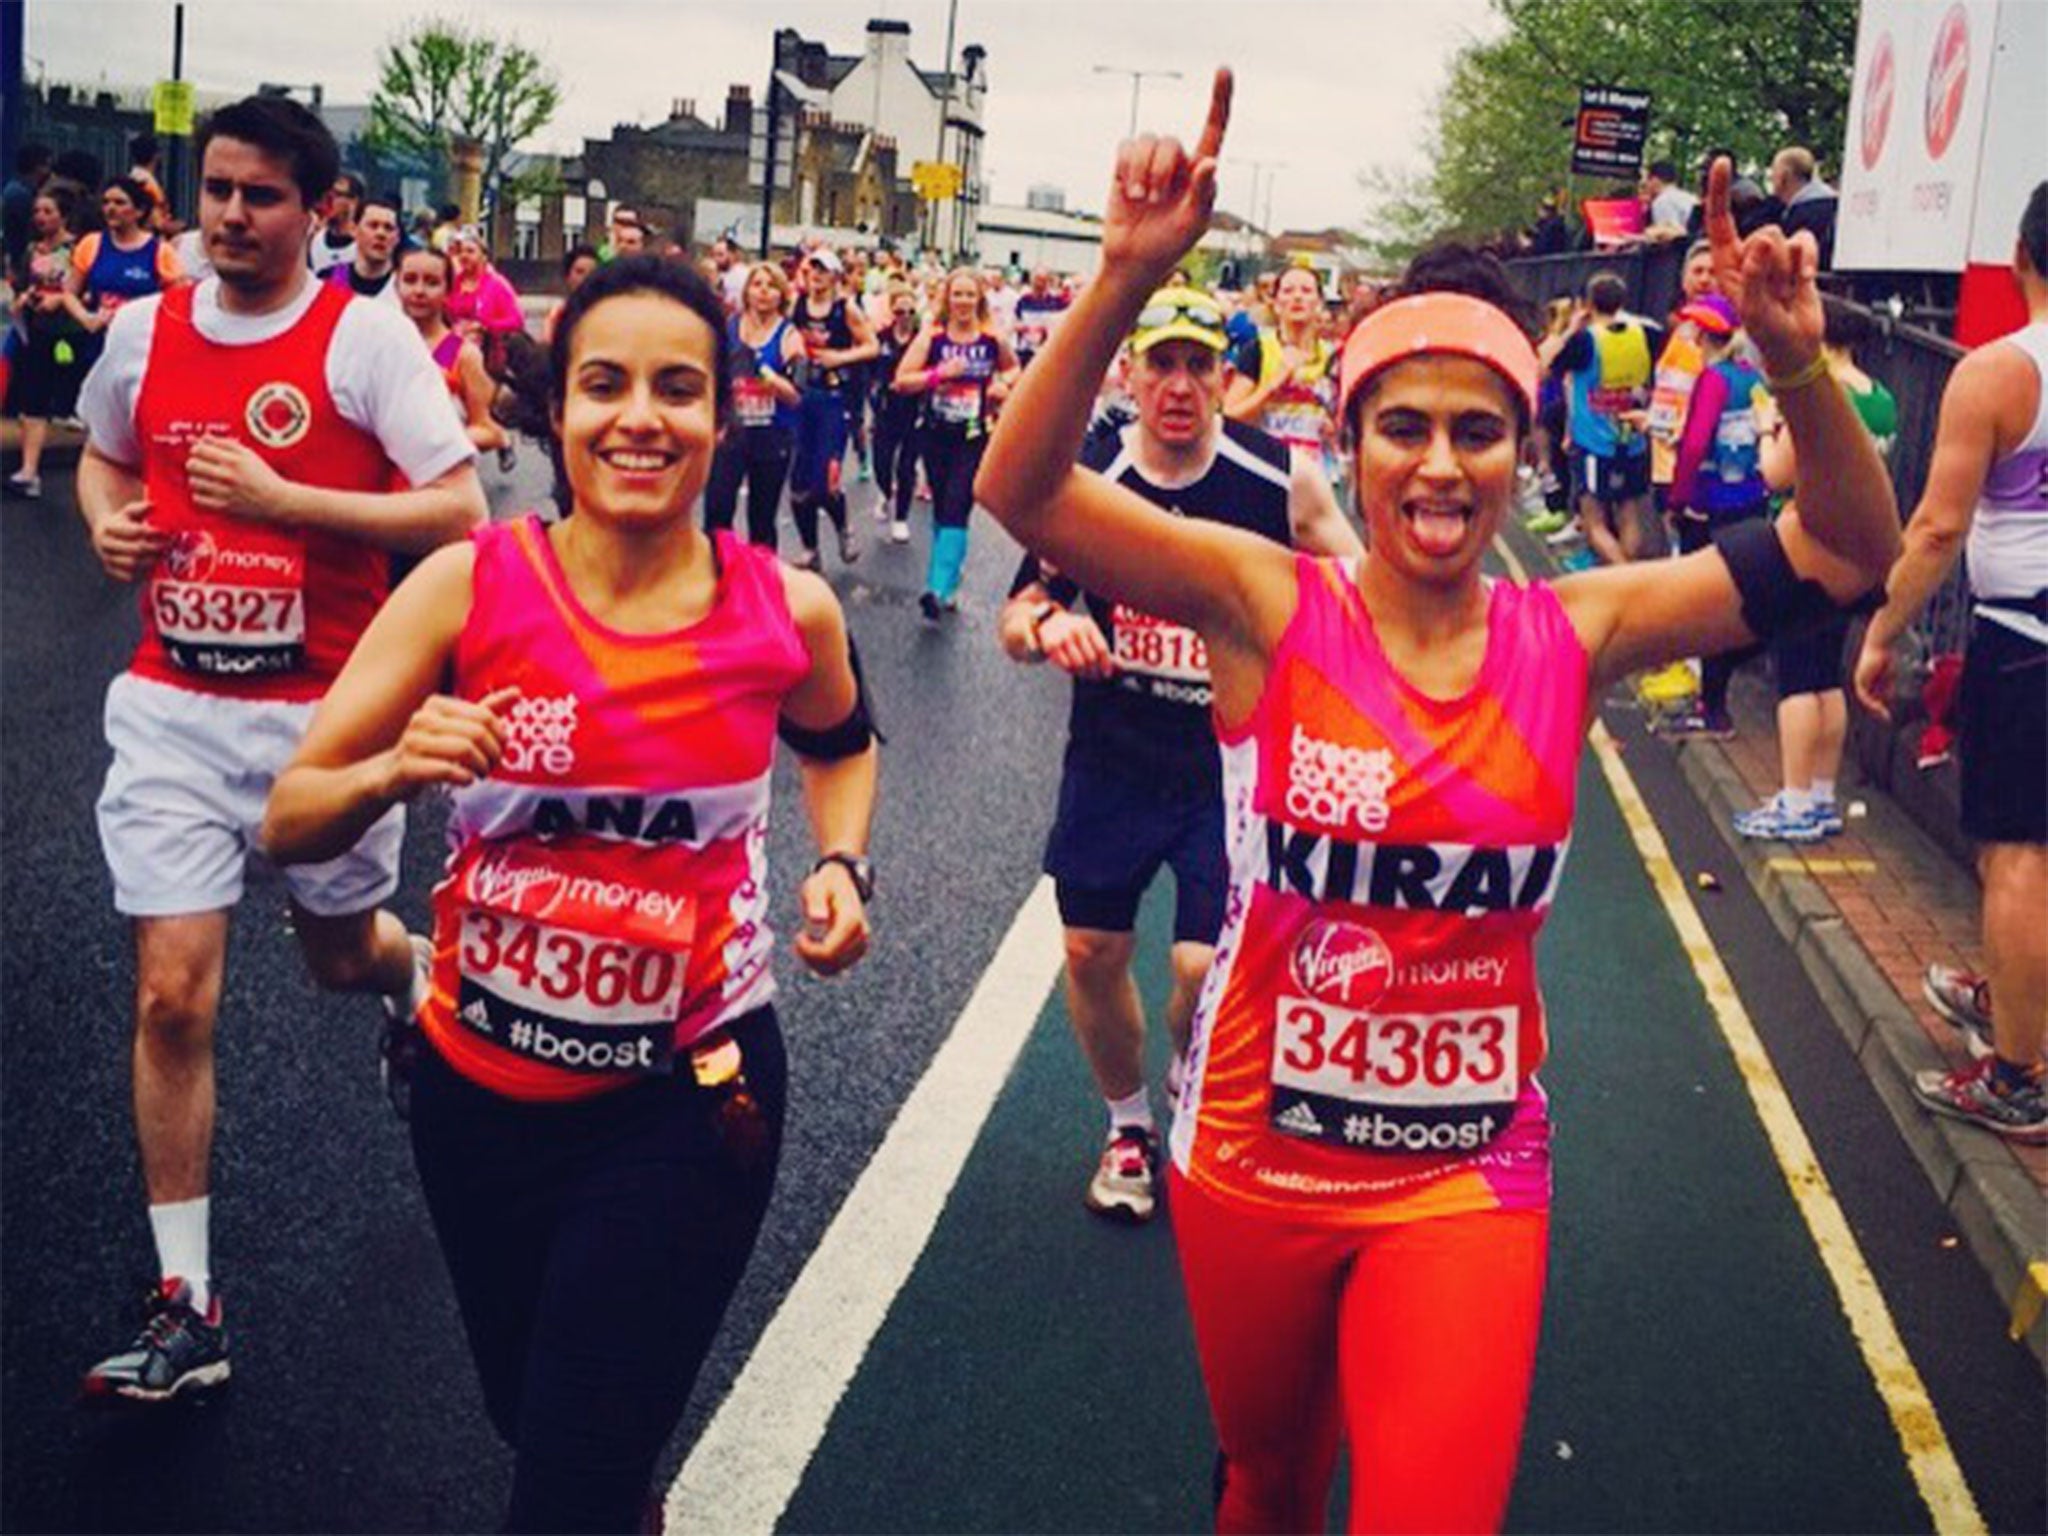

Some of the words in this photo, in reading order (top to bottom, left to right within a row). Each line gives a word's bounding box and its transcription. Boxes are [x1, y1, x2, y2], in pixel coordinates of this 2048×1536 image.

[219, 549, 294, 576] money
[156, 584, 296, 632] 53327
[500, 739, 575, 776] are
[1291, 723, 1394, 768] breast
[1288, 758, 1397, 799] cancer
[532, 796, 698, 841] ANA
[1285, 784, 1391, 833] care
[477, 855, 564, 913] Virgin
[568, 877, 687, 925] money
[463, 911, 676, 1008] 34360
[1298, 923, 1387, 1001] Virgin
[1395, 955, 1509, 987] money
[508, 1019, 654, 1067] #boost
[1283, 1007, 1506, 1087] 34363
[1343, 1113, 1496, 1150] #boost
